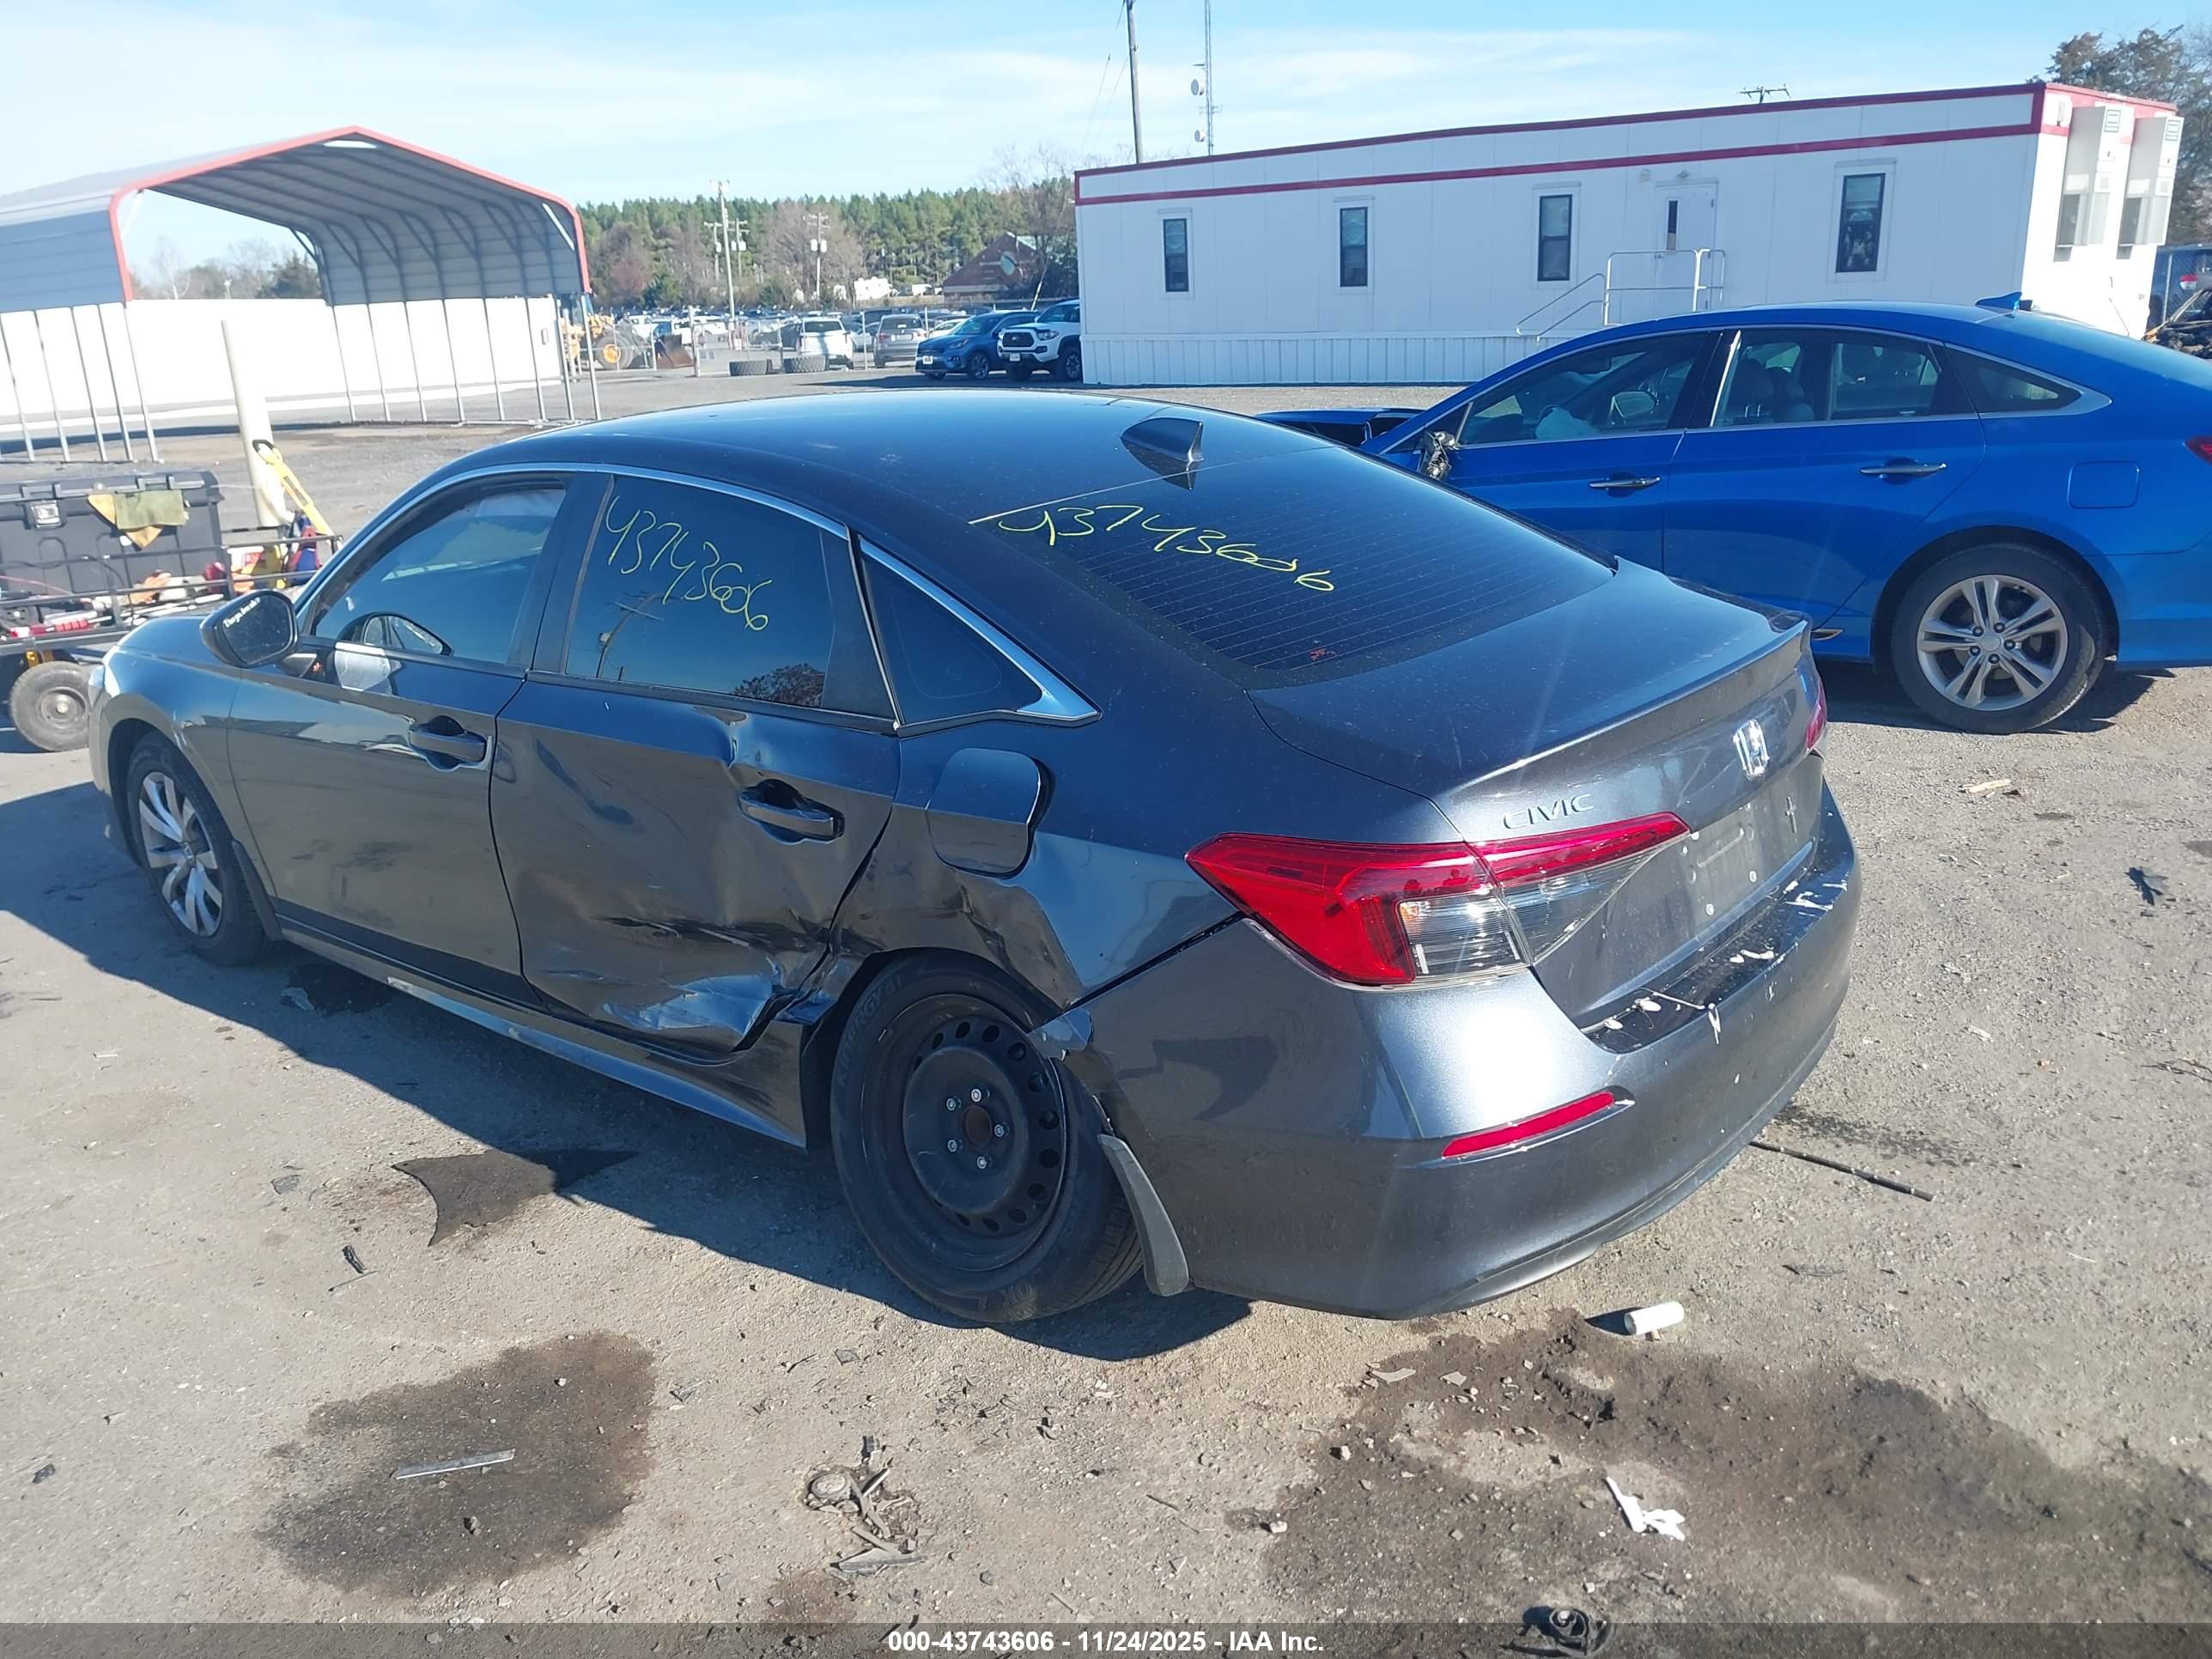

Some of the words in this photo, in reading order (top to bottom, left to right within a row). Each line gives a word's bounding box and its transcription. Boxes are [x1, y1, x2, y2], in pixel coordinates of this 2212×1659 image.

[605, 495, 773, 631] 43743606
[998, 505, 1335, 592] 43743606
[1504, 793, 1594, 830] CIVIC
